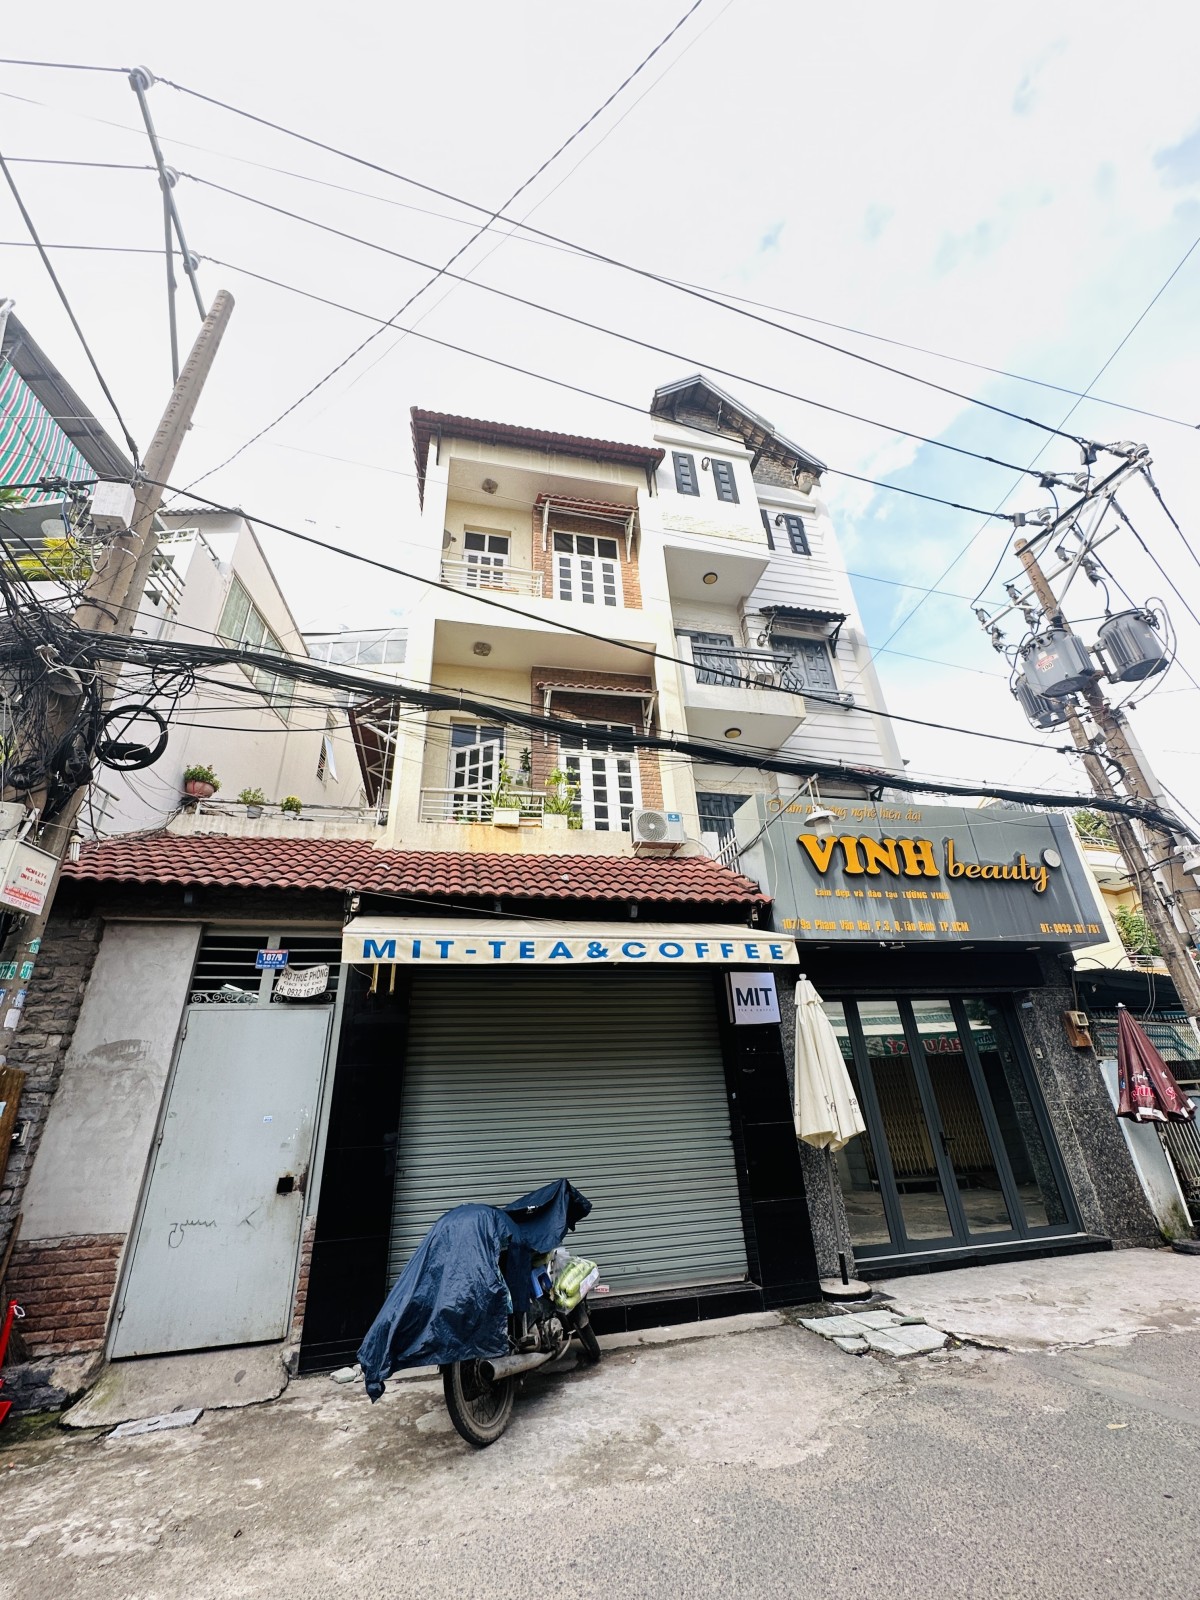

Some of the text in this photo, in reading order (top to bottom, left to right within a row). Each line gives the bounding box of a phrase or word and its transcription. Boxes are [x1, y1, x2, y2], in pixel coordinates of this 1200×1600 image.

[798, 834, 941, 876] VINH
[946, 838, 1050, 892] beauty
[263, 953, 283, 961] 107/9
[735, 987, 773, 1006] MIT
